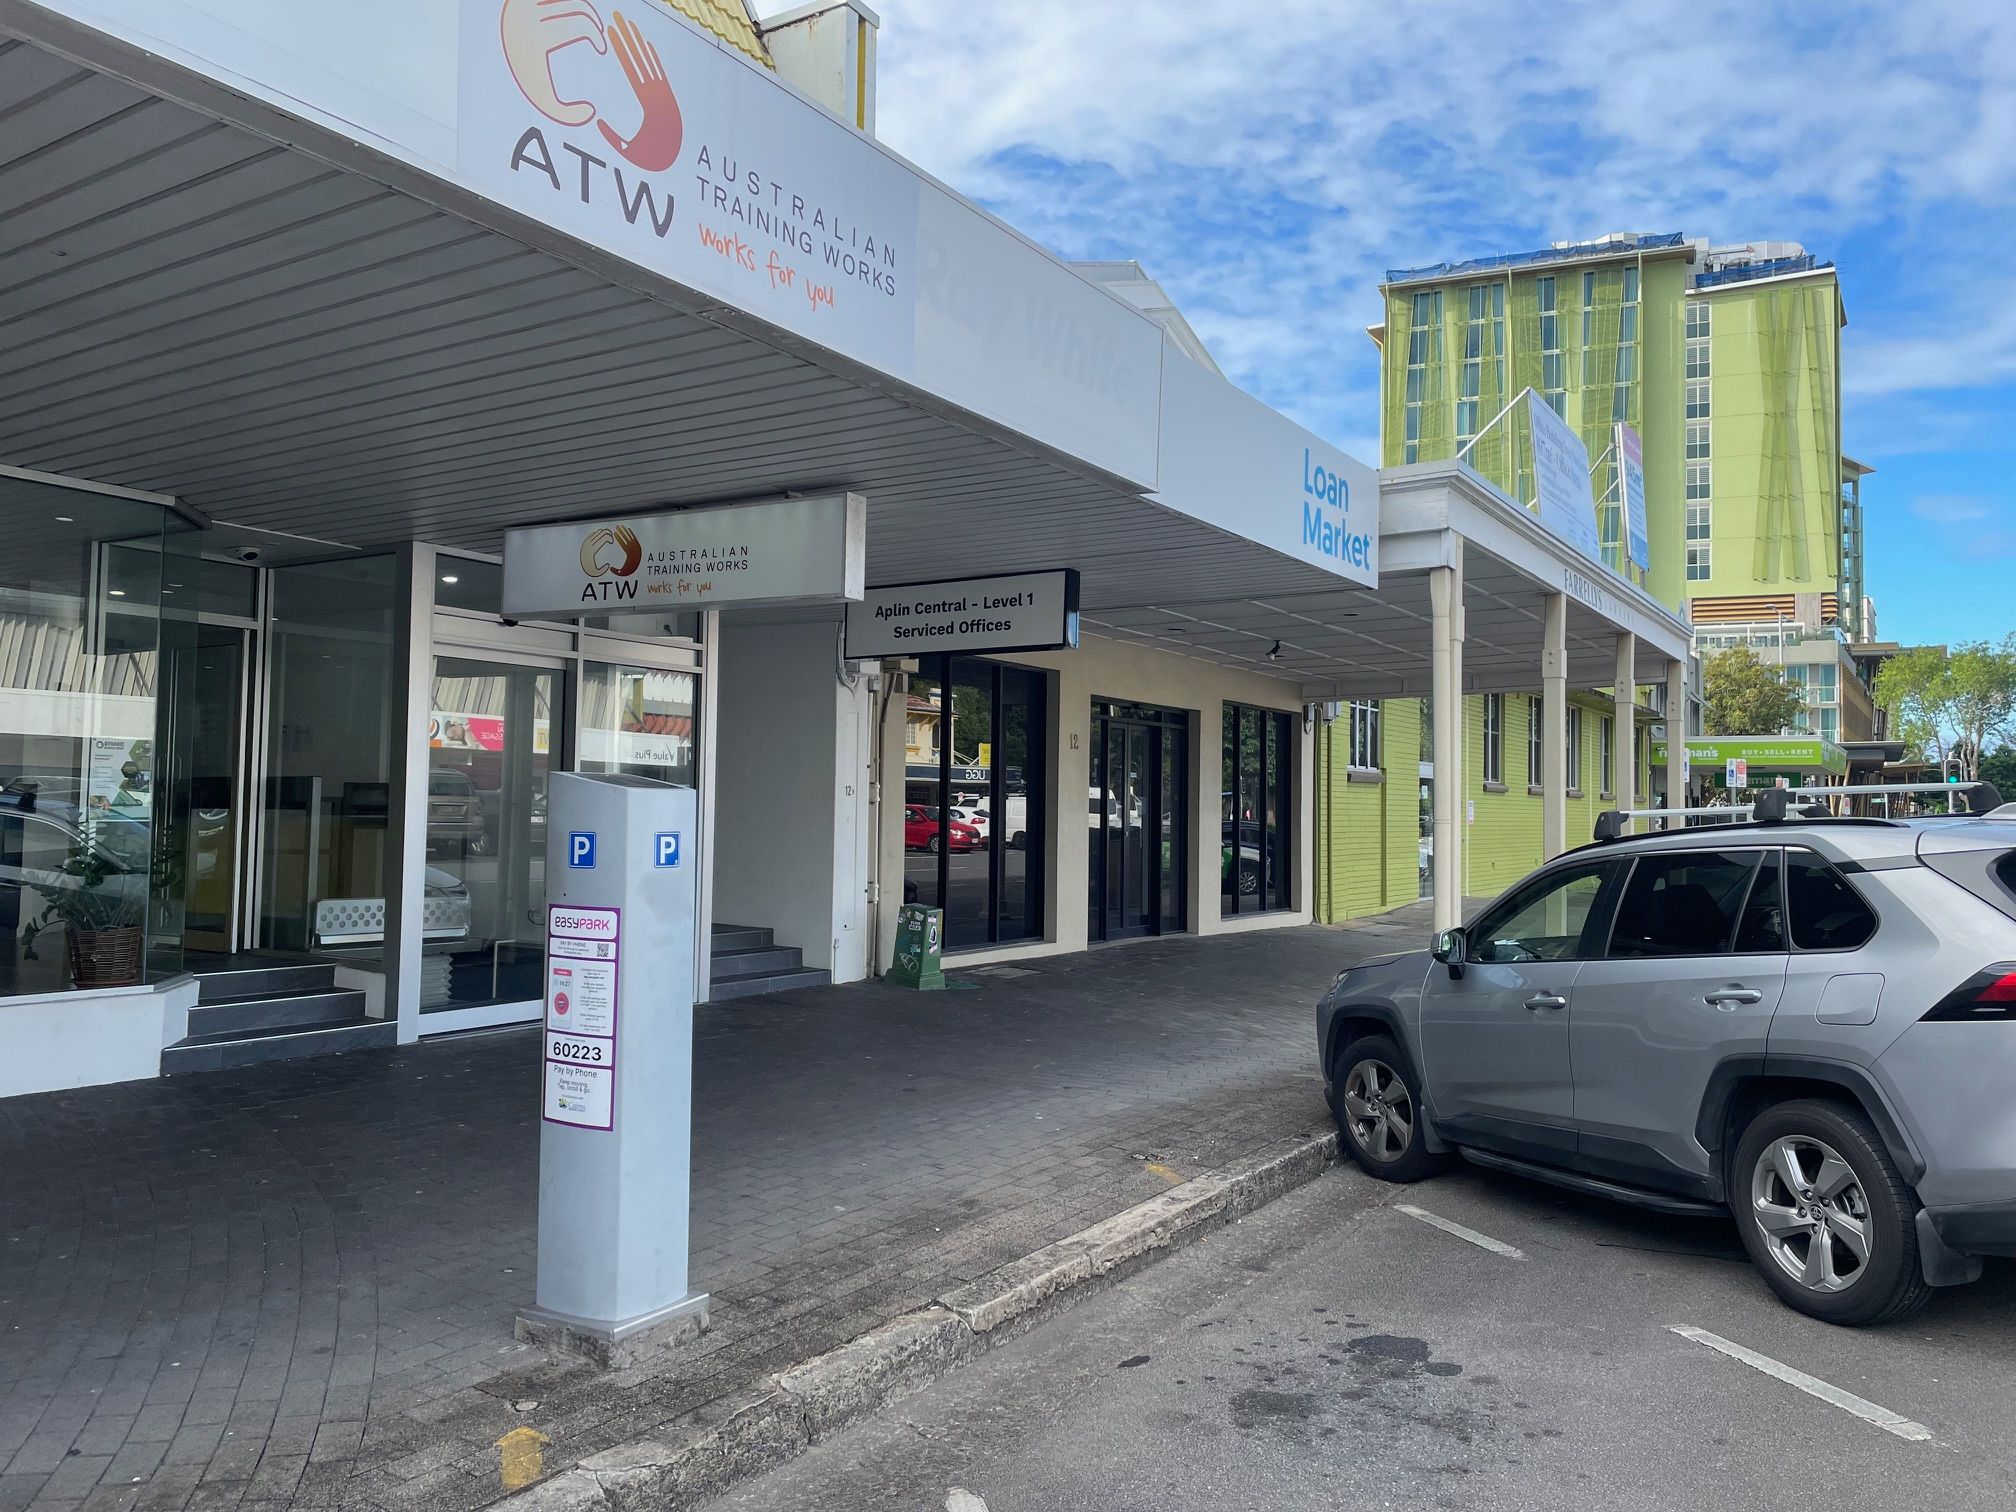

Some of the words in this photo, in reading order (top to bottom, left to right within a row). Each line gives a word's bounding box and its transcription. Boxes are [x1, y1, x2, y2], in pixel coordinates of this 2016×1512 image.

[510, 126, 675, 238] ATW
[697, 144, 895, 268] AUSTRALIAN
[696, 175, 813, 254] TRAINING
[822, 241, 896, 298] WORKS
[698, 222, 756, 274] works
[765, 251, 796, 289] for
[805, 278, 835, 312] you
[1303, 448, 1349, 512] Loan
[1302, 501, 1371, 571] Market
[647, 545, 749, 563] AUSTRALIAN
[647, 562, 701, 576] TRAINING
[705, 559, 749, 572] WORKS
[581, 580, 639, 602] ATW
[647, 580, 673, 595] works
[677, 578, 695, 597] for
[695, 580, 713, 595] you
[874, 603, 911, 620] Aplin
[914, 597, 968, 617] Central
[983, 592, 1024, 612] Level
[1027, 592, 1035, 606] 1
[893, 620, 956, 640] Serviced
[959, 615, 1012, 636] Offices
[1069, 733, 1079, 750] 12
[574, 836, 590, 865] P
[660, 836, 676, 864] P
[553, 1041, 602, 1061] 60223
[553, 1064, 564, 1076] Pay
[565, 1066, 574, 1077] by
[575, 1068, 598, 1079] Phone
